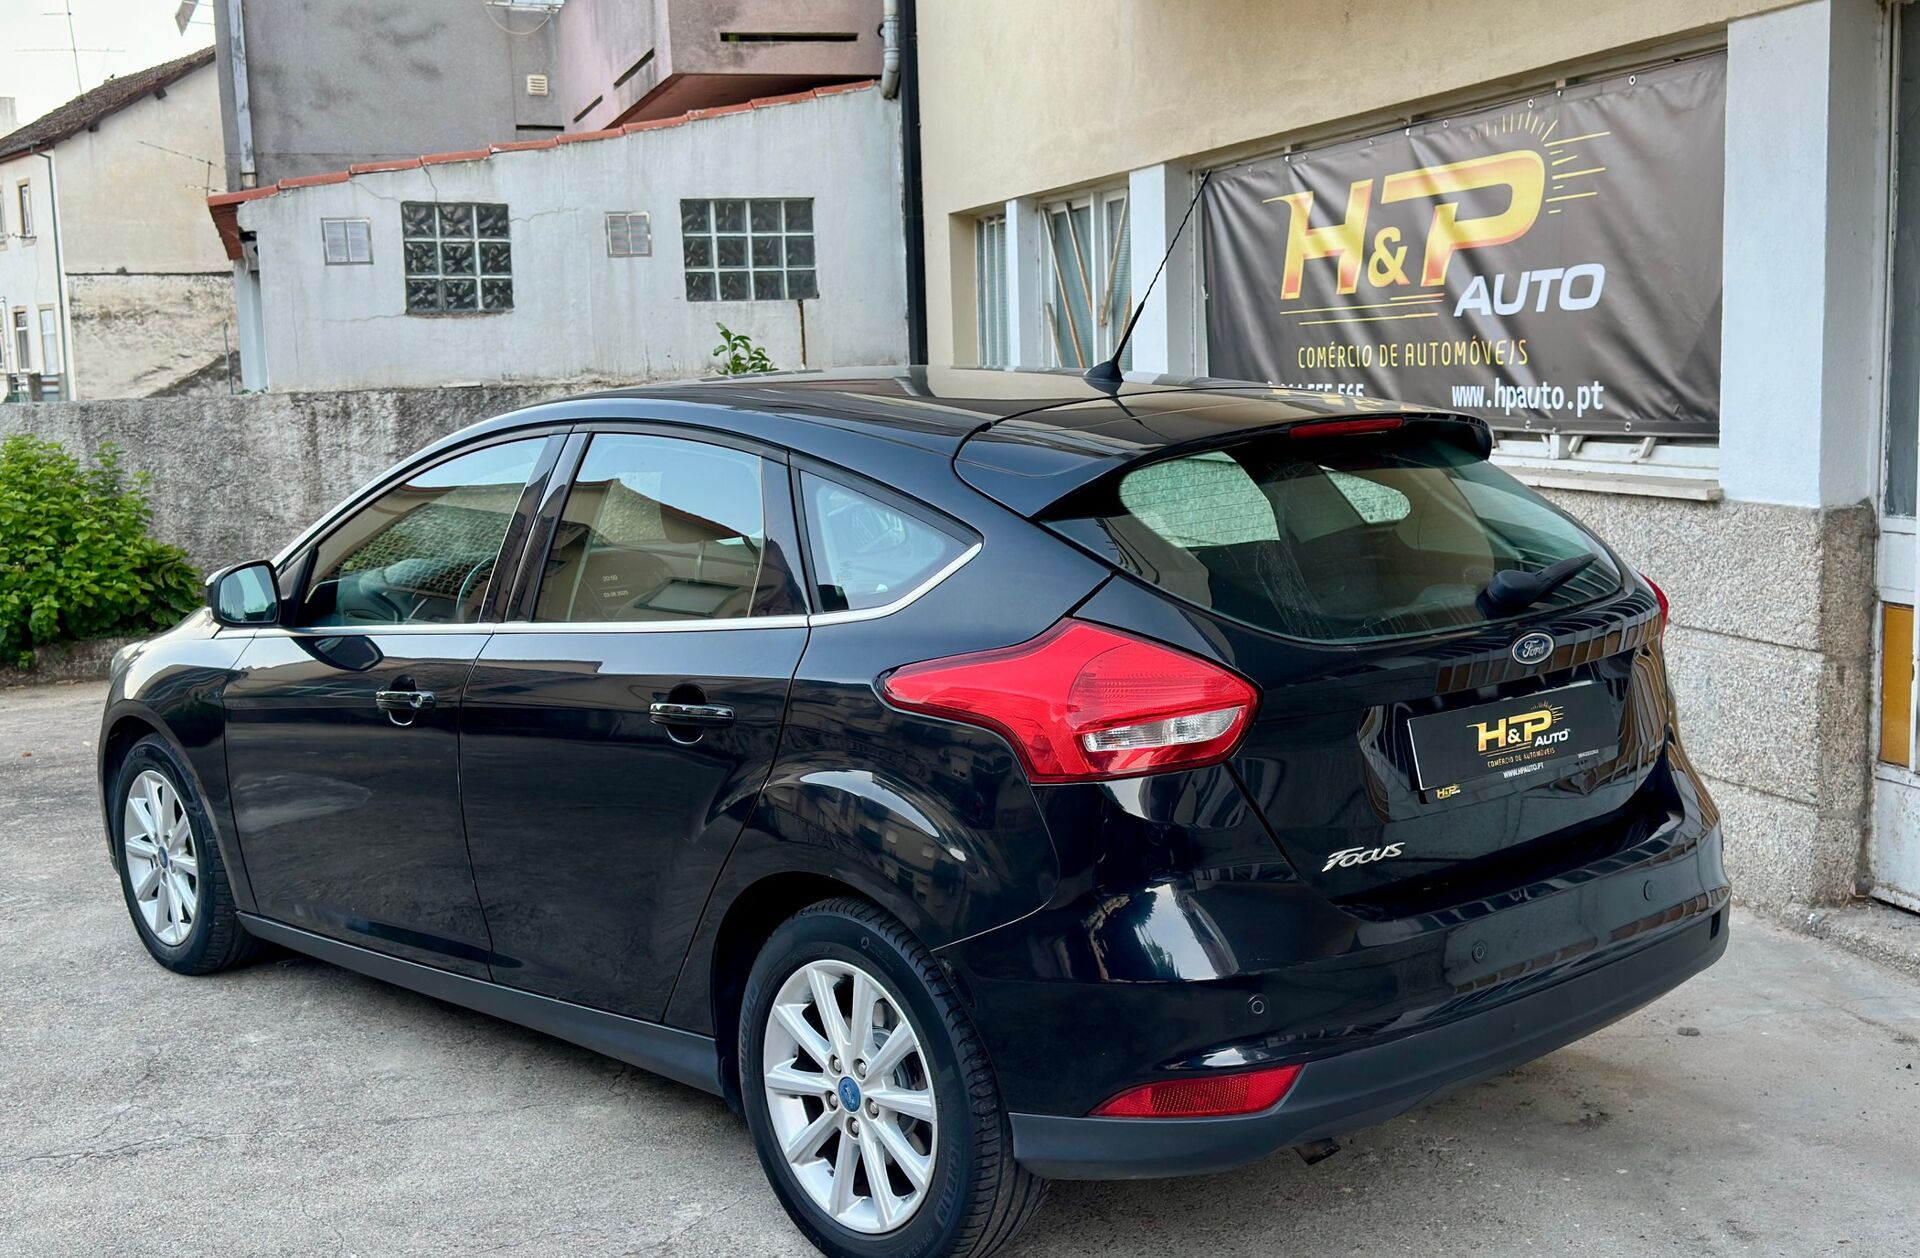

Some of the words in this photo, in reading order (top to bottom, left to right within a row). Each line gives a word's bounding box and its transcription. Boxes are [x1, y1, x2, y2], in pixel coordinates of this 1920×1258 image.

[1264, 149, 1546, 301] H&P
[1453, 263, 1606, 318] AUTO
[1298, 341, 1373, 369] COMÉRCIO
[1379, 344, 1399, 368] DE
[1404, 336, 1529, 367] AUTOMÓVEIS
[1451, 380, 1605, 415] www.hpauto.pt
[1522, 640, 1545, 658] Ford
[1468, 709, 1552, 752] H&P
[1534, 730, 1568, 748] AUTO
